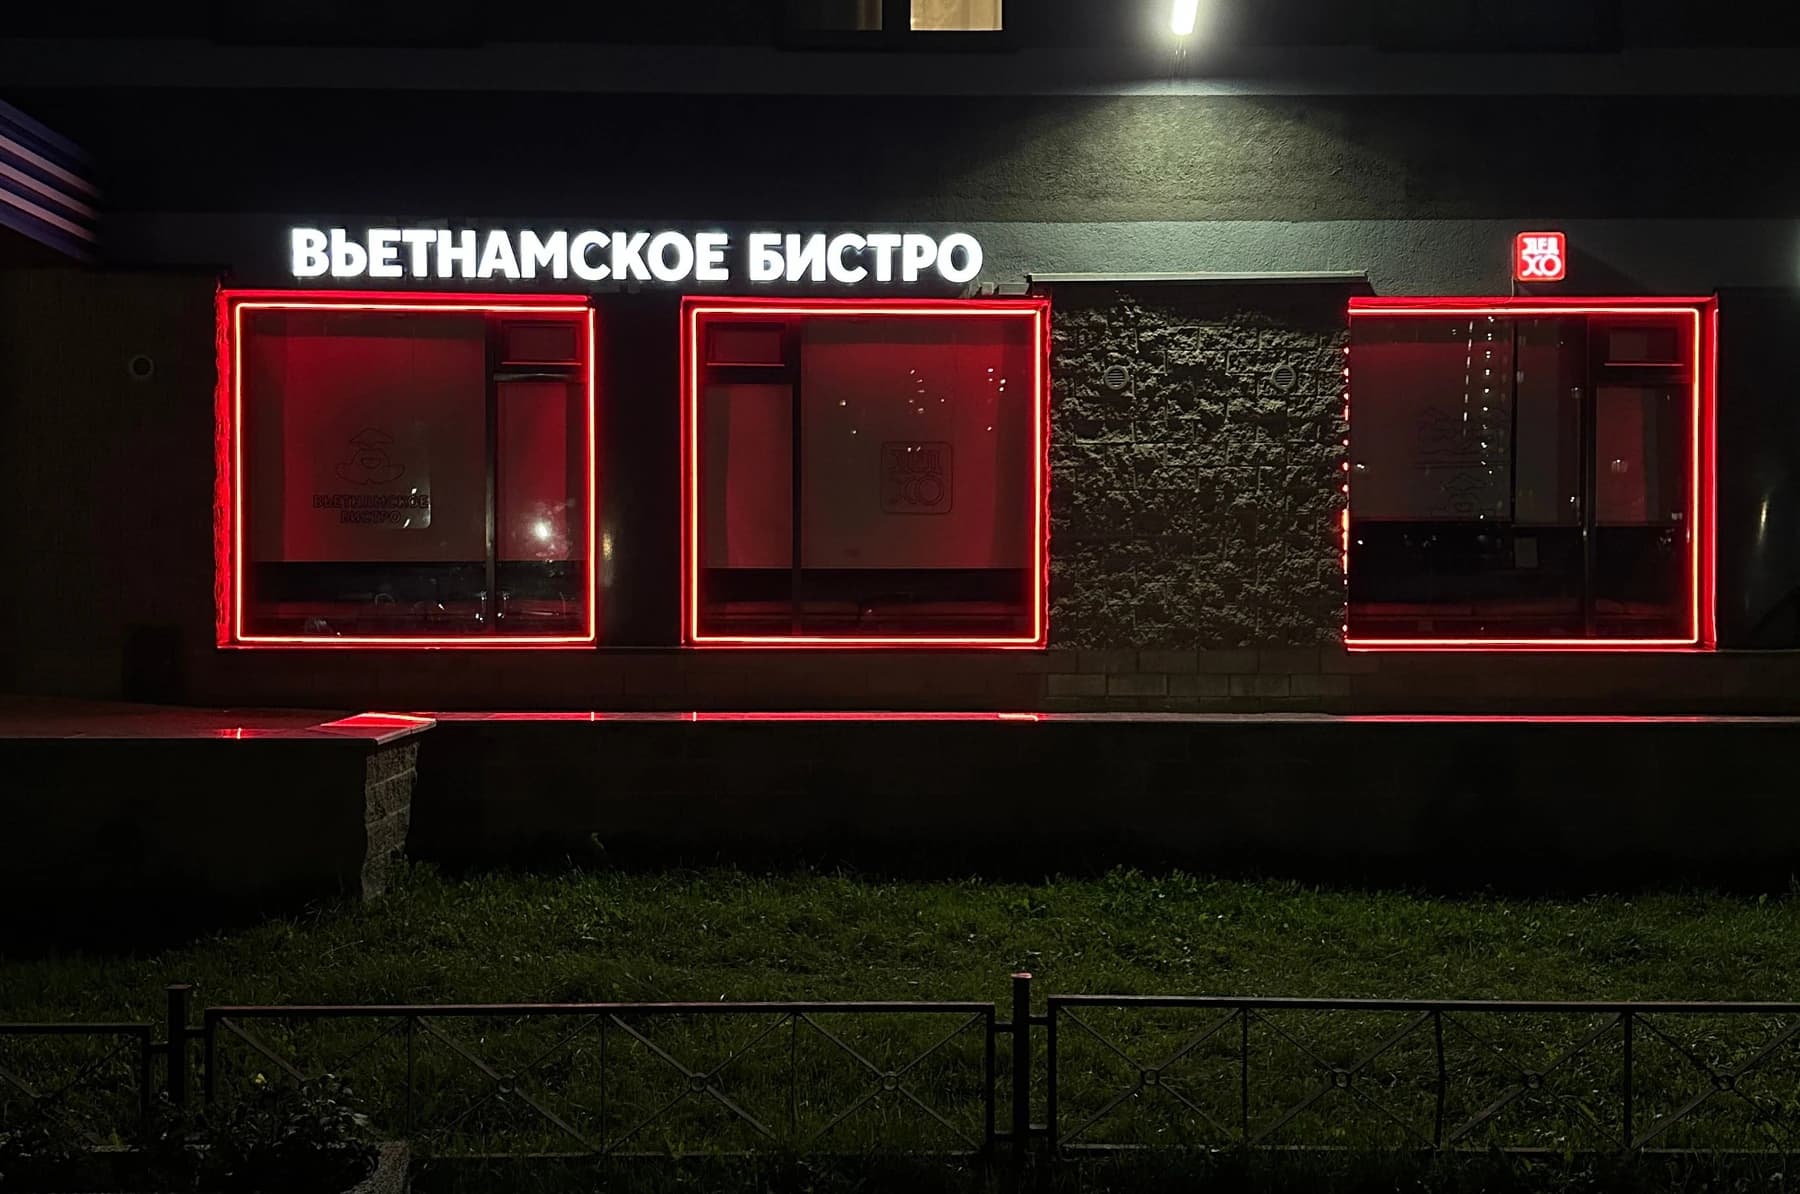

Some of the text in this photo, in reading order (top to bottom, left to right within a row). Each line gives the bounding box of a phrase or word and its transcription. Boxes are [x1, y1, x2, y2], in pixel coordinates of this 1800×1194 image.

[291, 228, 984, 284] ВЬЕТНАМСКОЕ БИСТРО
[1522, 254, 1562, 277] ХО
